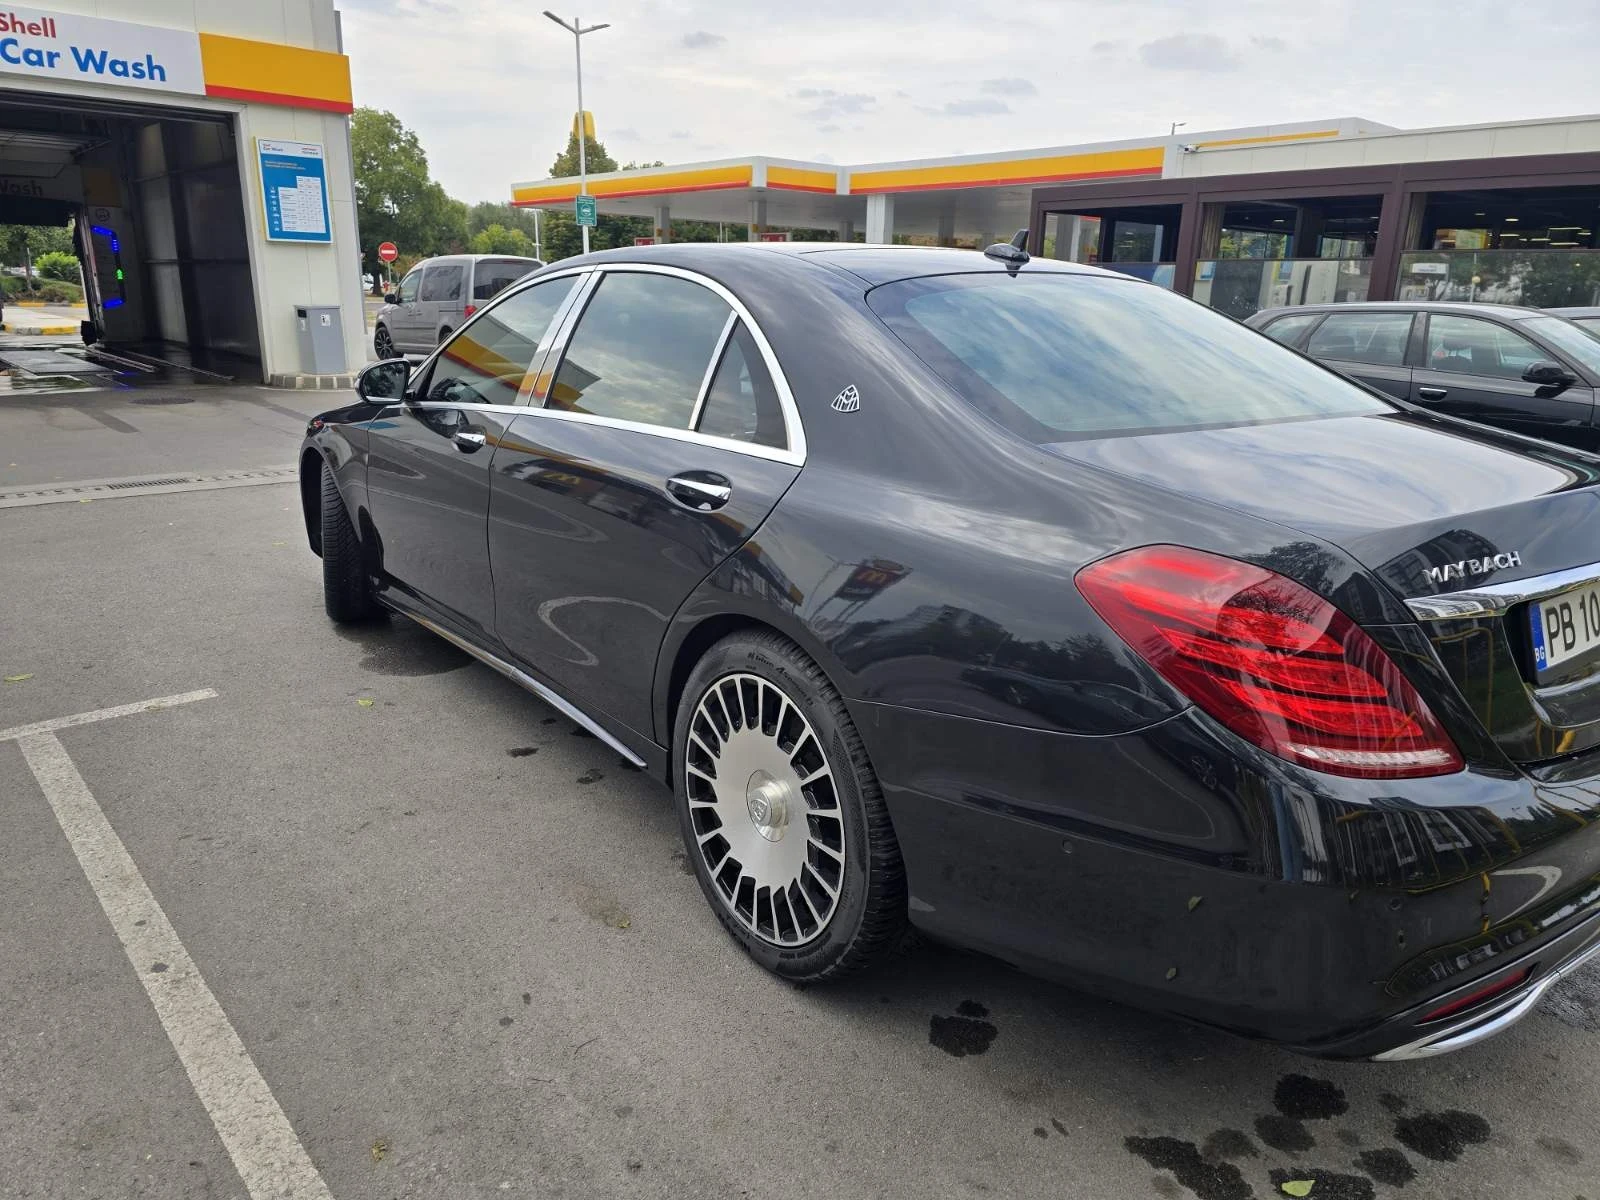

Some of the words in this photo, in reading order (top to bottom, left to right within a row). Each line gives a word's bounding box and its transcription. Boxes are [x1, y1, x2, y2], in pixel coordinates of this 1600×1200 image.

[0, 12, 57, 38] Shell
[0, 37, 60, 68] Car
[70, 46, 167, 82] Wash
[1422, 550, 1521, 584] MAYBACH
[1545, 601, 1576, 659] PB
[1579, 590, 1600, 642] 10
[1534, 645, 1545, 663] BG
